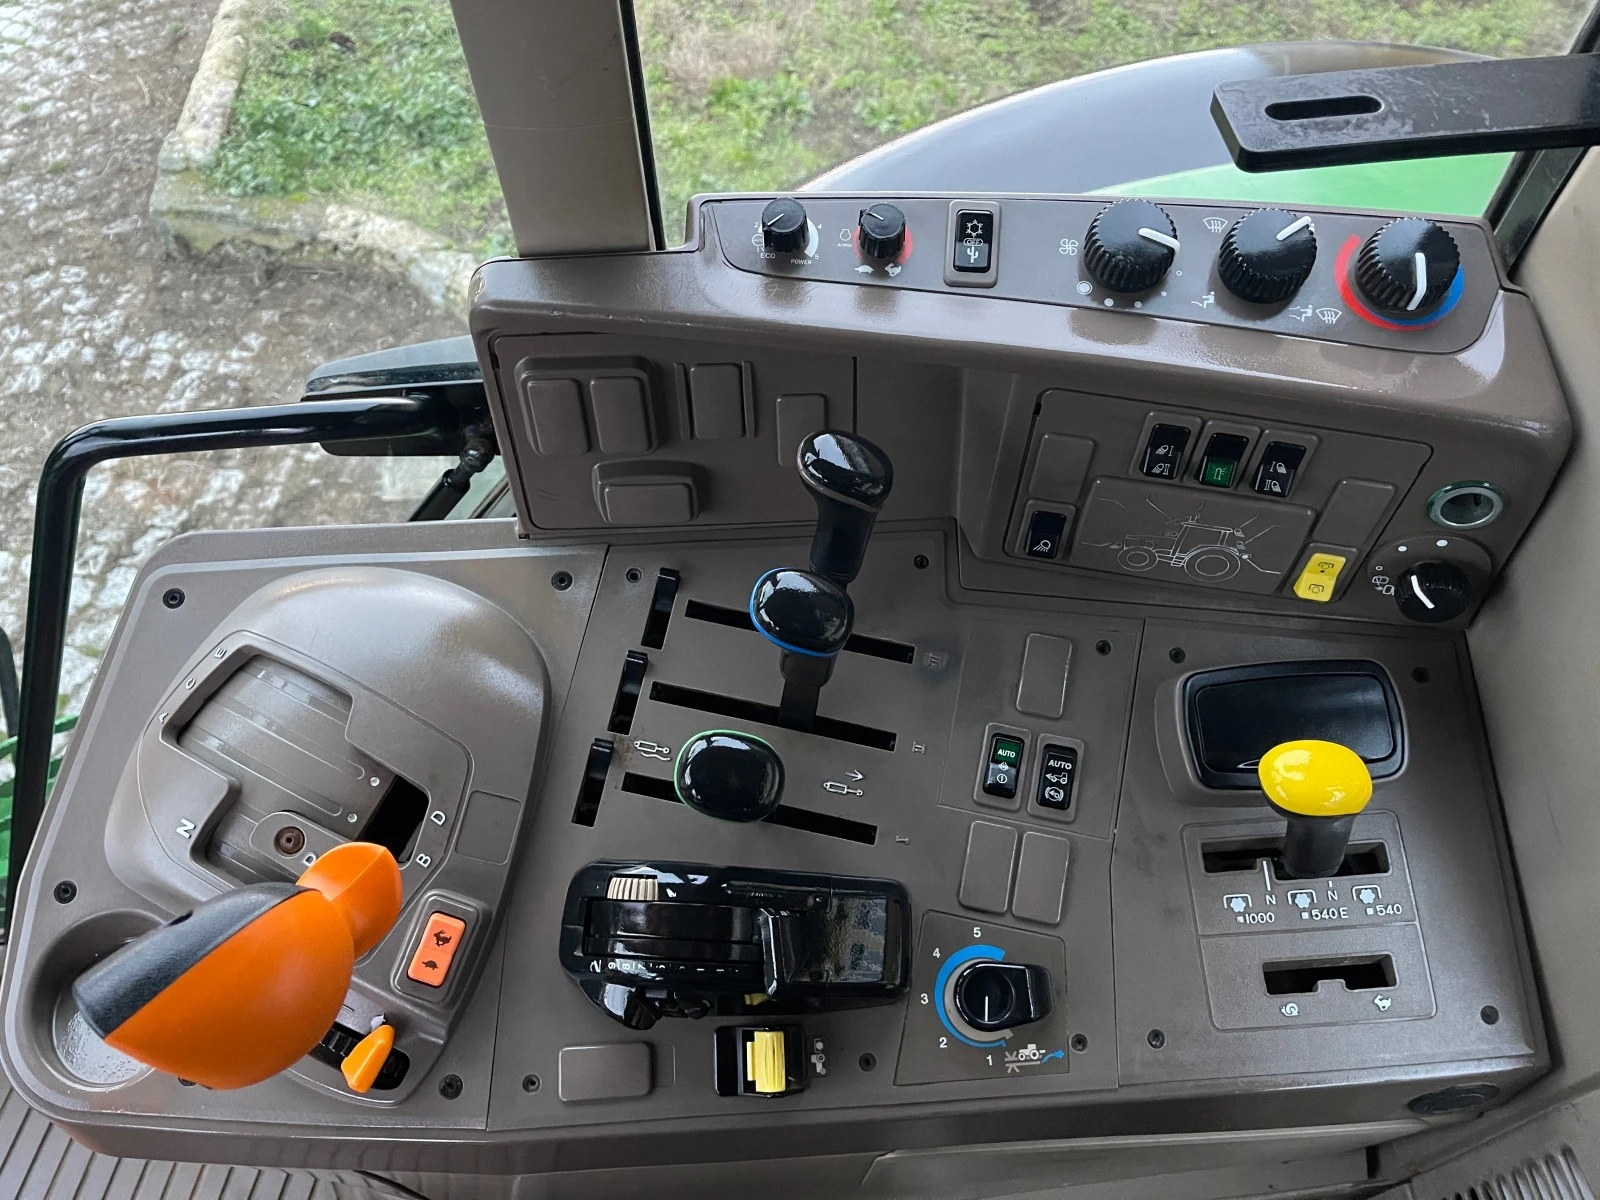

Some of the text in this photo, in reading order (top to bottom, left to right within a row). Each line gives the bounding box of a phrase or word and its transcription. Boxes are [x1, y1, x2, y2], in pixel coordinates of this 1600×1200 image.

[214, 648, 226, 658] E
[186, 678, 196, 690] C
[159, 712, 169, 724] A
[997, 748, 1016, 759] AUTO
[1048, 759, 1072, 770] AUTO
[431, 811, 446, 826] D
[176, 818, 196, 839] N
[415, 853, 431, 868] B
[1265, 895, 1277, 905] N
[1327, 890, 1339, 901] N
[1312, 907, 1349, 920] 540 E
[1376, 903, 1403, 916] 540
[1245, 911, 1275, 924] 1000
[973, 927, 981, 938] 5
[932, 948, 941, 958] 4
[920, 993, 929, 1004] 3
[939, 1036, 948, 1048] 2
[986, 1054, 993, 1066] 1
